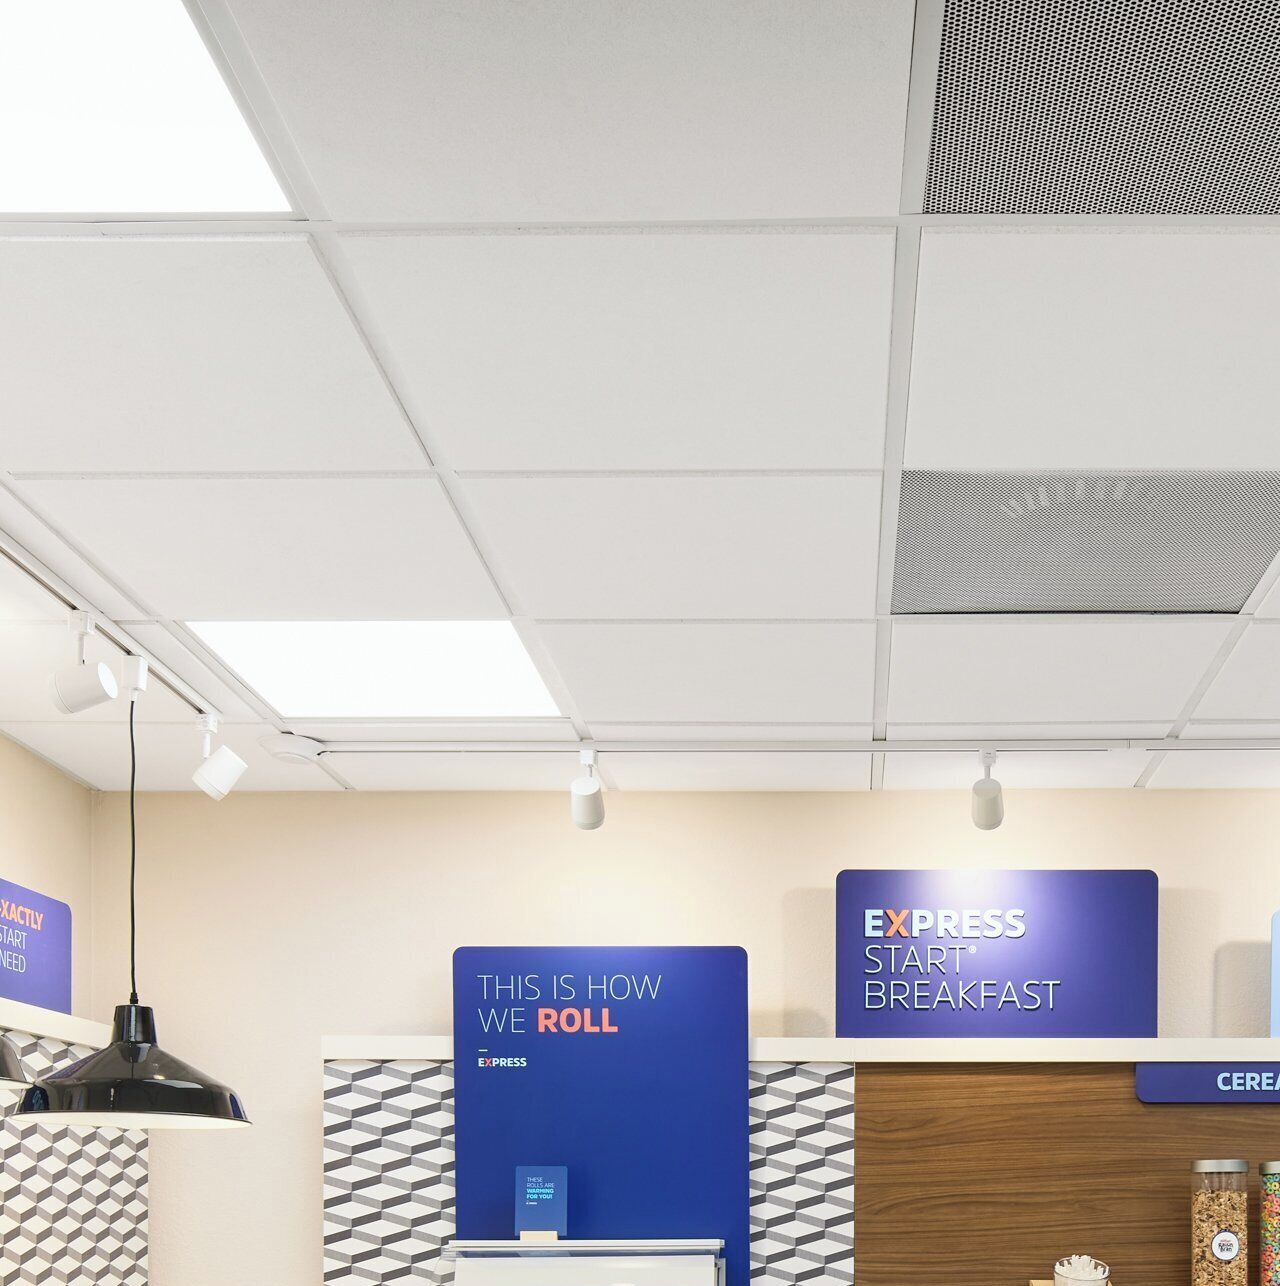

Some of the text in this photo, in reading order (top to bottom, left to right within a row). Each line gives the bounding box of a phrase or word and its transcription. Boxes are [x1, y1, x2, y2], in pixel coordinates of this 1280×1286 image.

[863, 908, 1027, 939] EXPRESS
[477, 974, 662, 1000] THIS IS HOW
[865, 980, 1061, 1011] BREAKFAST
[478, 1007, 619, 1034] WE ROLL
[478, 1057, 527, 1067] EXPRESS
